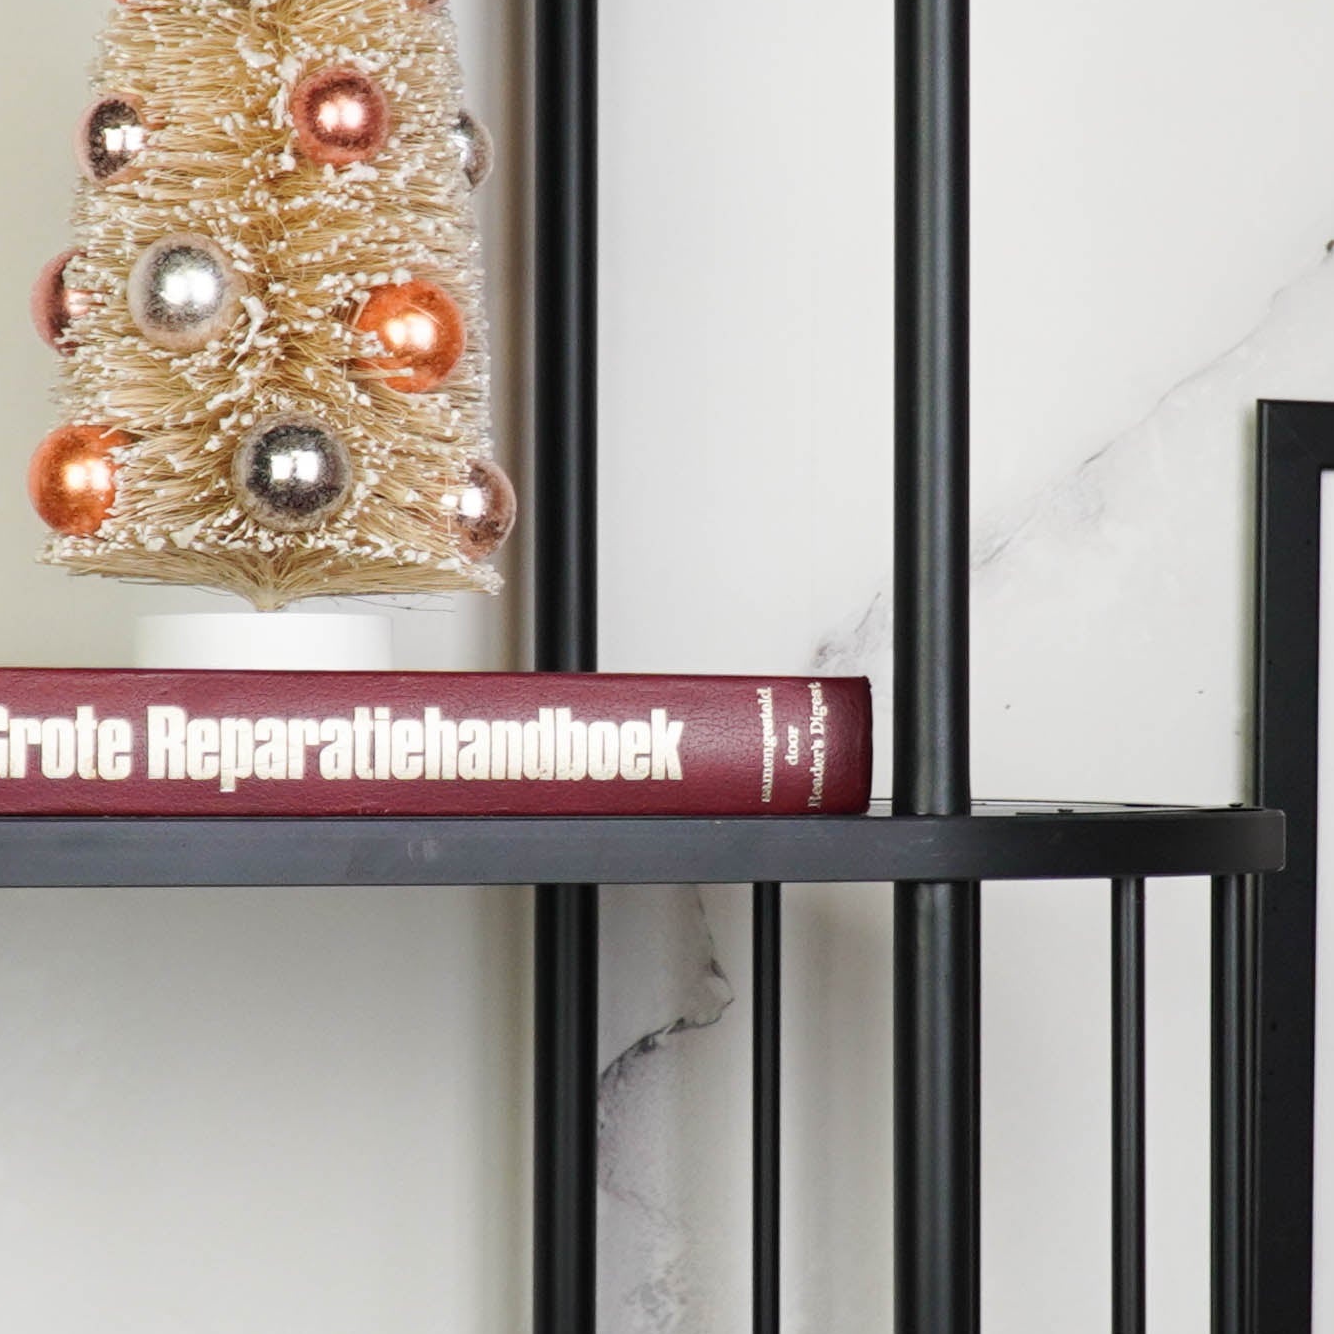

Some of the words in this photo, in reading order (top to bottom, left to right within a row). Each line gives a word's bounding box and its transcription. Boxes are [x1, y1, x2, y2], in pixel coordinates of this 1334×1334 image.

[807, 681, 828, 735] Digest
[147, 706, 684, 792] Reparatiehandboek
[784, 724, 799, 766] door
